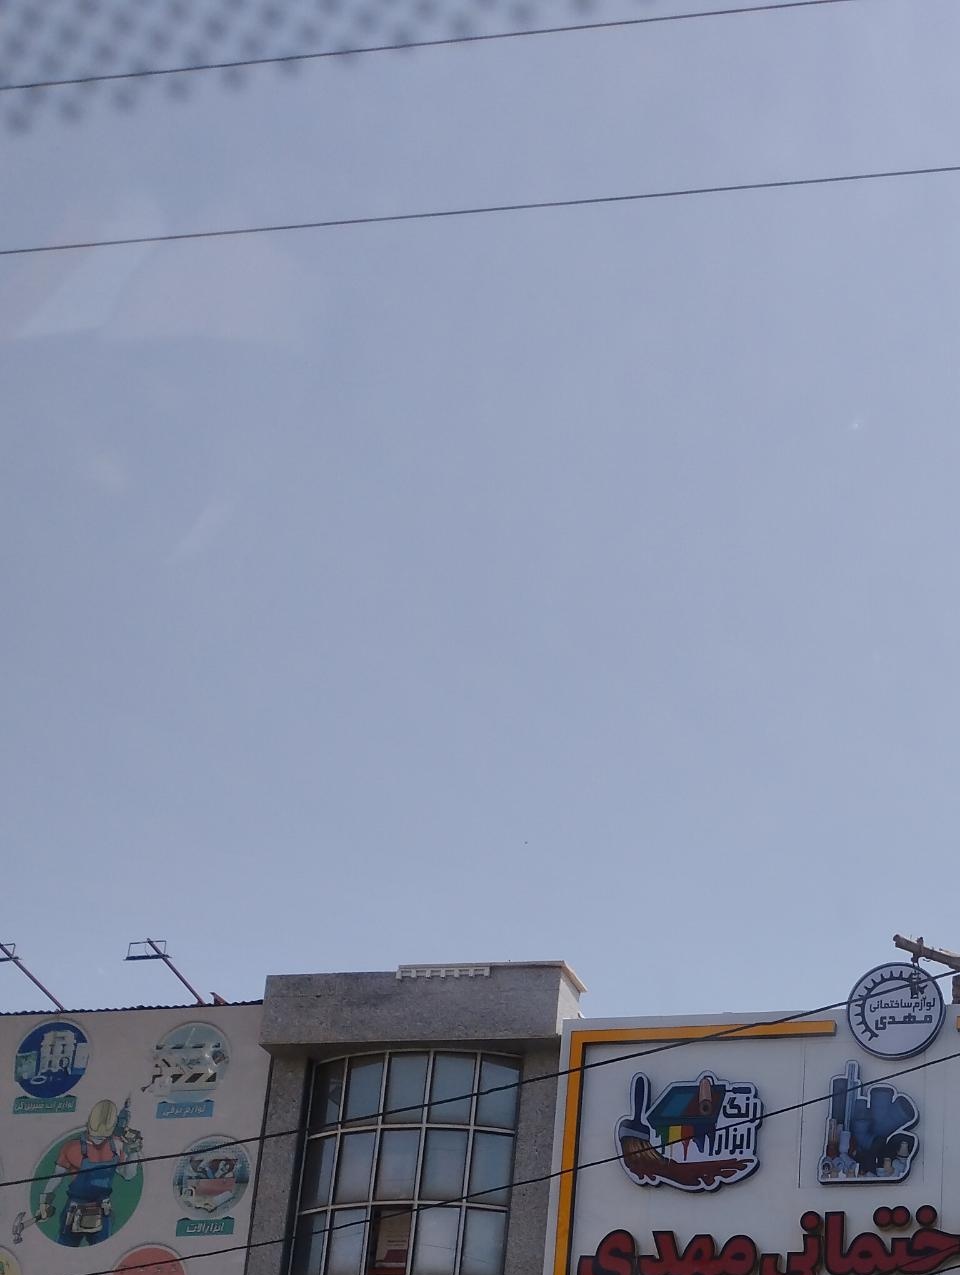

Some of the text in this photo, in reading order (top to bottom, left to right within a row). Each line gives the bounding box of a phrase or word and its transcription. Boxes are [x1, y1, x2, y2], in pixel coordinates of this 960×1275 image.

[870, 997, 936, 1013] لوازم ساختمانی
[874, 1013, 933, 1031] مهدی
[722, 1096, 758, 1123] رنگ
[714, 1126, 752, 1156] ابزار
